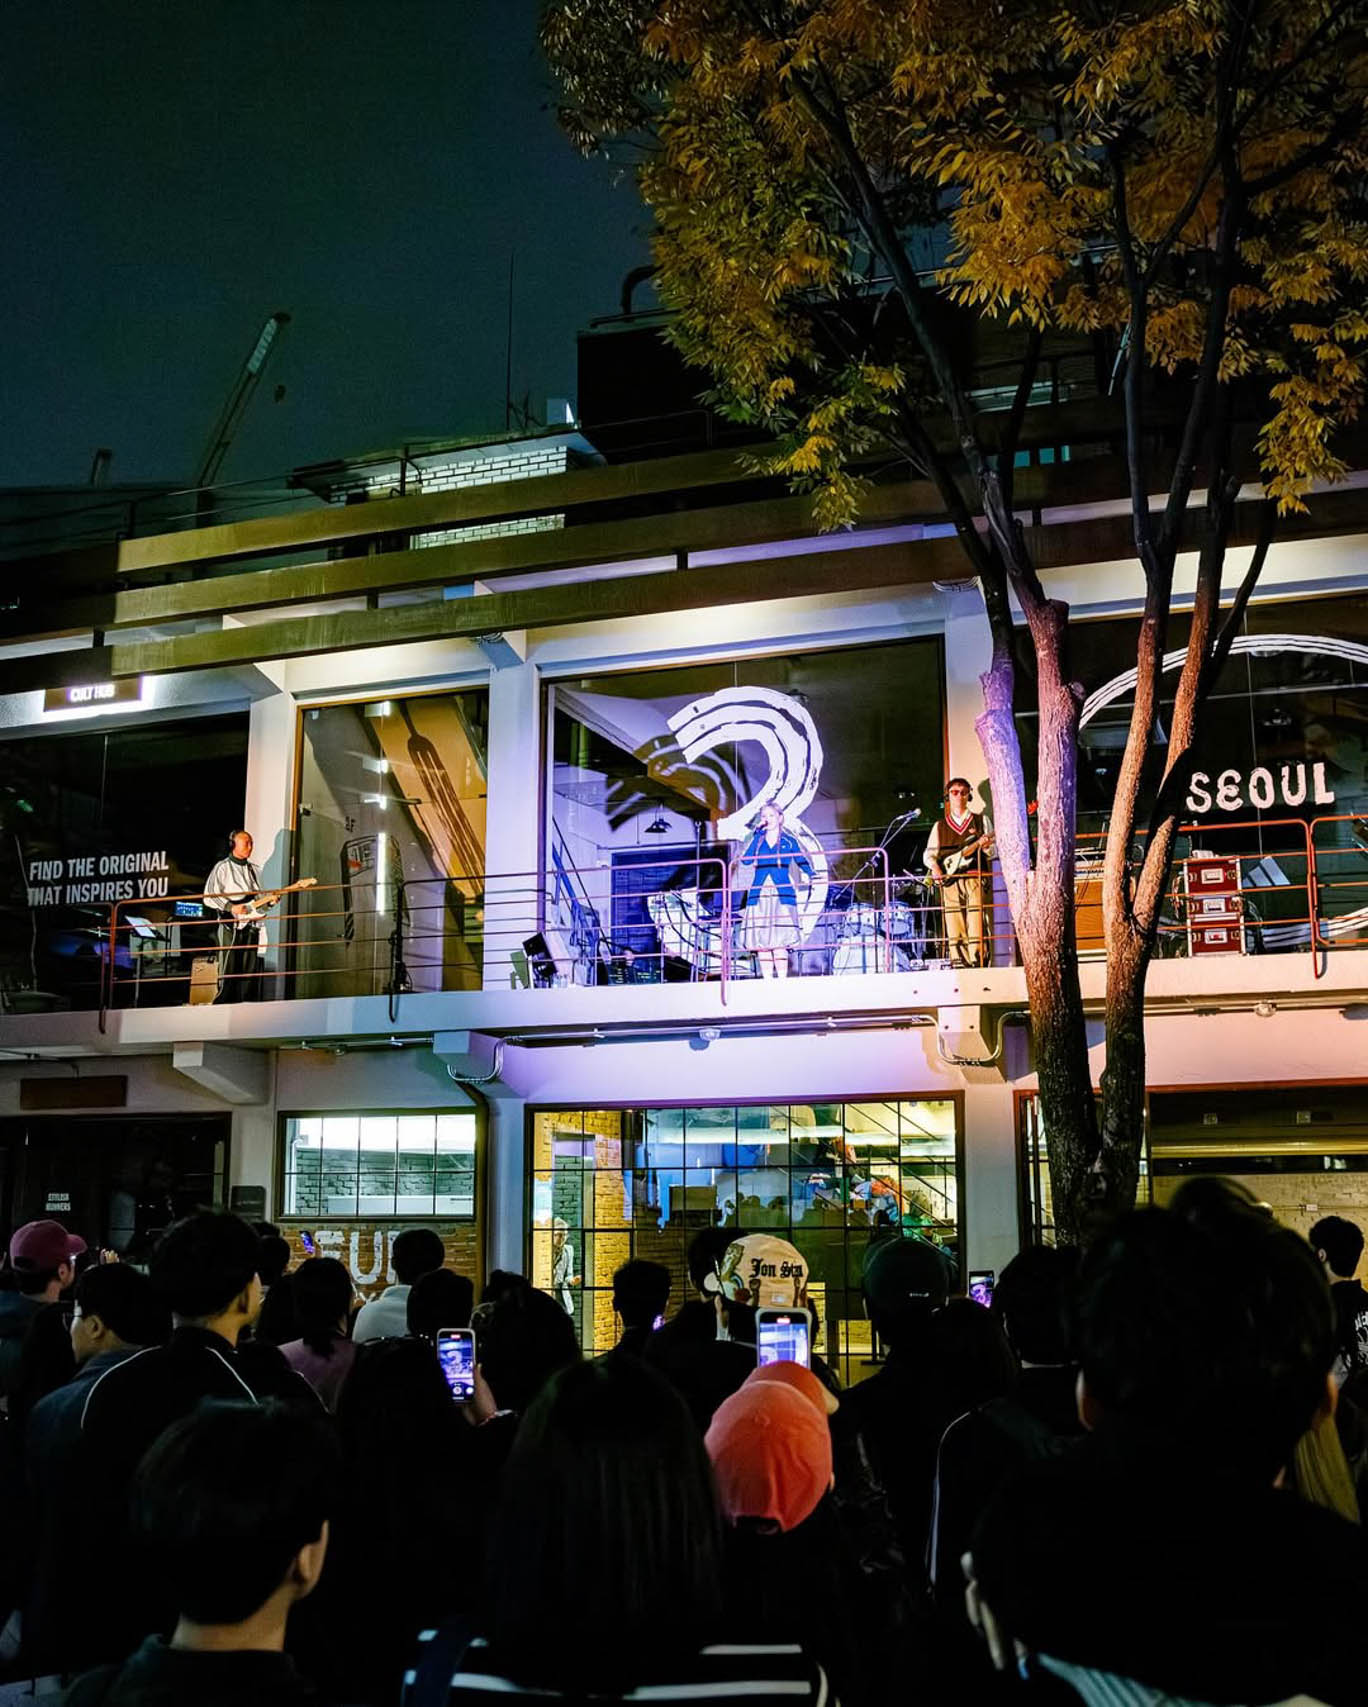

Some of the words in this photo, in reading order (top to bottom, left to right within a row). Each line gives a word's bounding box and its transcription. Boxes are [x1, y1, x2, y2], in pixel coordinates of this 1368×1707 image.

[1186, 762, 1335, 814] SEOUL
[29, 861, 63, 881] FIND
[67, 857, 95, 878] THE
[99, 850, 169, 876] ORIGINAL
[27, 886, 62, 907] THAT
[66, 880, 134, 904] INSPIRES
[138, 877, 169, 899] YOU
[749, 1257, 777, 1279] Jon
